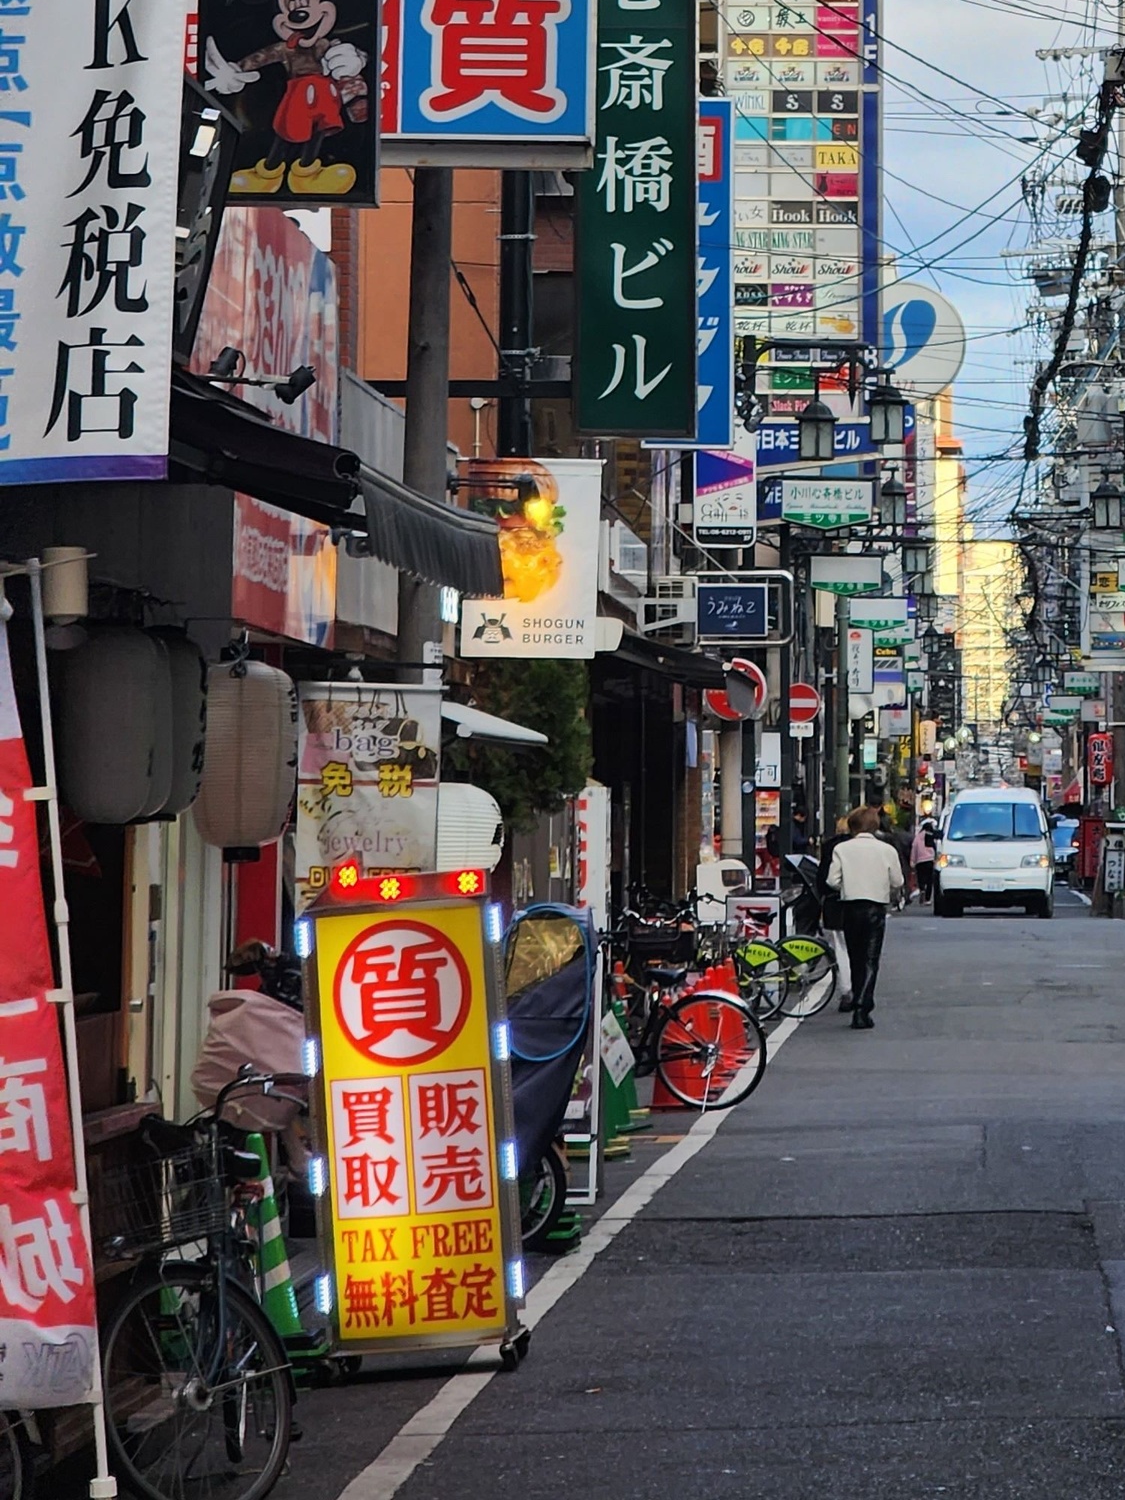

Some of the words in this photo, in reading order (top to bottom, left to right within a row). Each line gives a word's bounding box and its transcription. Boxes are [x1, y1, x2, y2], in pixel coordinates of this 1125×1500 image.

[819, 152, 856, 165] TAKA
[772, 208, 810, 222] Hook
[523, 618, 585, 630] SHOGUN
[523, 633, 584, 645] BURGER
[332, 727, 397, 756] bag
[320, 761, 413, 798] 免税
[352, 942, 448, 1045] 質
[342, 1087, 402, 1208] 買取
[419, 1080, 486, 1206] 販売
[342, 1225, 398, 1263] TAX
[411, 1218, 493, 1259] FREE
[345, 1262, 499, 1329] 無料査定
